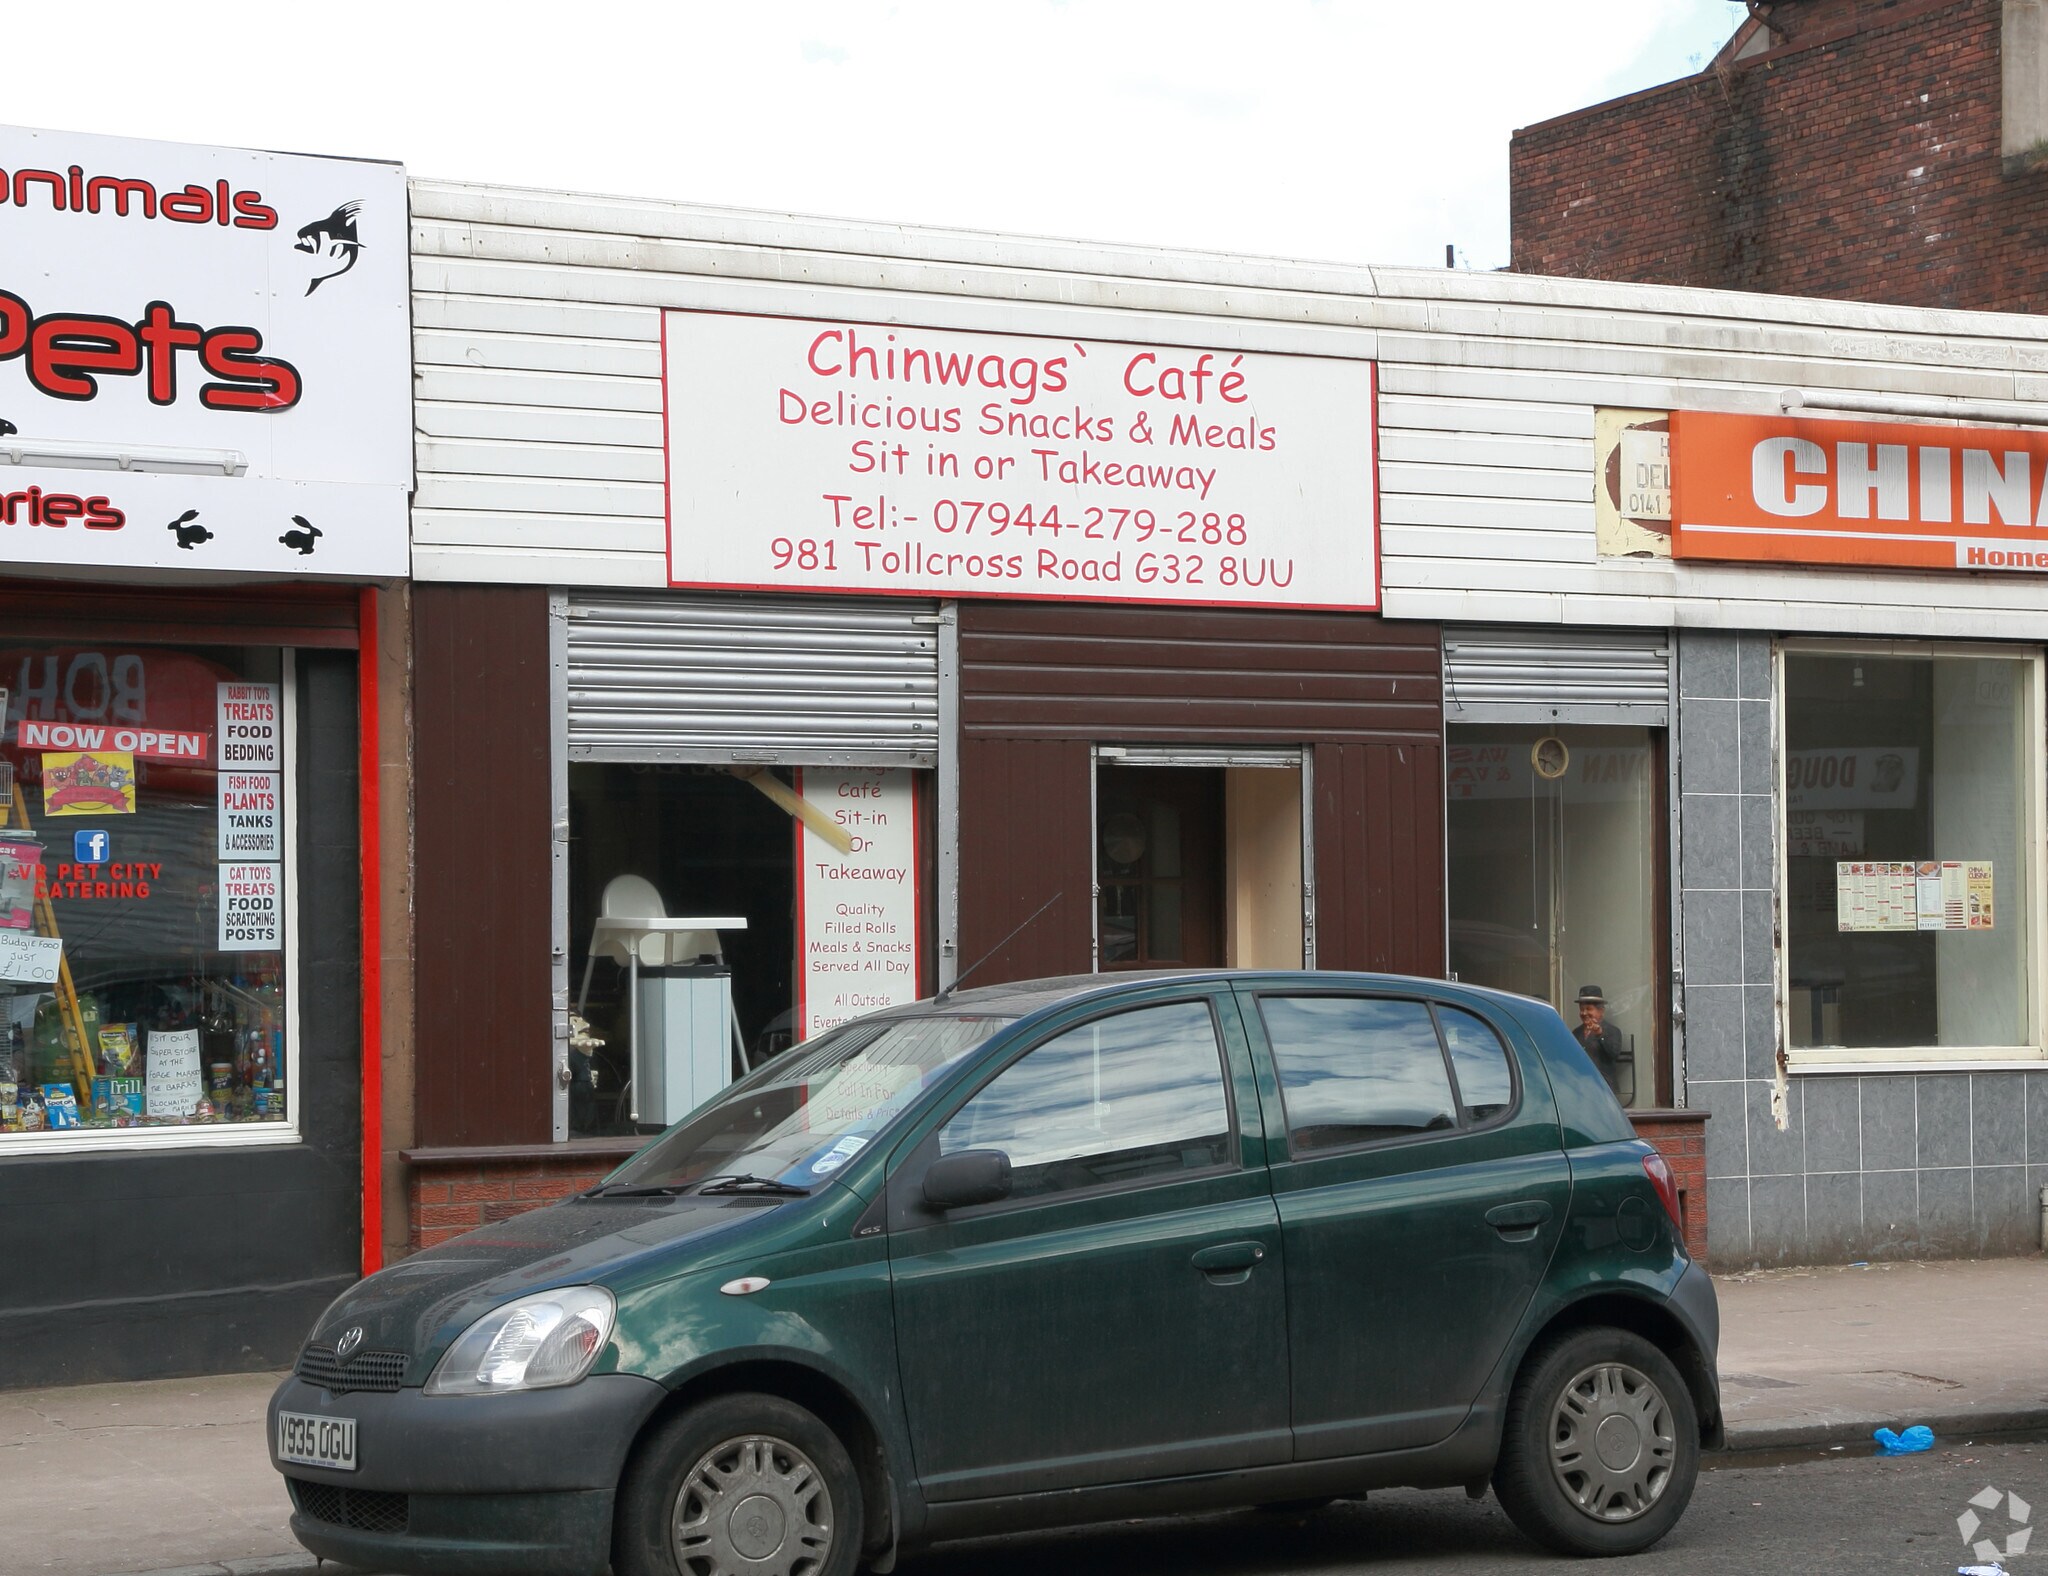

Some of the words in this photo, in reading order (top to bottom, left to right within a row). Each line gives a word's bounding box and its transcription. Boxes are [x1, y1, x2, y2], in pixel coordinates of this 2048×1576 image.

[0, 164, 279, 231] nimals
[1123, 352, 1249, 405] Café
[779, 388, 961, 433] Delicious
[978, 403, 1114, 442] Snacks
[1128, 410, 1154, 446] &
[1168, 413, 1277, 451] Meals
[849, 440, 910, 476] Sit
[926, 443, 960, 478] in
[974, 456, 1015, 481] or
[1031, 448, 1217, 501] Takeaway
[1752, 436, 2048, 527] CHIN
[0, 485, 126, 531] ries
[822, 494, 918, 531] Tel:-
[933, 499, 1248, 546] 07944-279-288
[770, 537, 838, 571] 981
[854, 540, 1023, 578] Tollcross
[1037, 548, 1121, 582] Road
[1135, 552, 1204, 584] G32
[1218, 556, 1294, 588] 8UU
[227, 686, 251, 700] RABBIT
[253, 687, 270, 700] TOYS
[223, 703, 274, 721] TREATS
[26, 724, 106, 749] NOW
[114, 731, 200, 756] OPEN
[227, 725, 273, 739] FOOD
[225, 744, 274, 762] BEDDING
[228, 776, 247, 790] FISH
[248, 776, 271, 790] FOOD
[837, 780, 882, 799] Café
[224, 792, 275, 811] PLANTS
[228, 815, 273, 828] TANKS
[834, 809, 887, 825] Sit-in
[225, 833, 230, 851] &
[231, 833, 275, 851] ACCESSORIES
[850, 836, 873, 853] Or
[18, 863, 48, 881] VR
[58, 863, 100, 881] PET
[110, 863, 163, 880] CITY
[229, 866, 247, 880] CAT
[248, 866, 271, 880] TOYS
[815, 863, 907, 885] Takeaway
[33, 881, 151, 899] CATERING
[224, 882, 275, 896] TREATS
[228, 897, 274, 911] FOOD
[835, 903, 885, 918] Quality
[225, 911, 275, 927] SCRATCHING
[825, 922, 861, 934] Filled
[865, 922, 896, 934] Rolls
[225, 928, 275, 941] POSTS
[809, 941, 848, 953] Meals
[852, 941, 862, 953] &
[866, 941, 911, 953] Snacks
[812, 960, 859, 972] Served
[864, 960, 881, 972] All
[886, 960, 910, 975] Day
[834, 993, 848, 1006] All
[851, 993, 891, 1006] Outside
[280, 1415, 315, 1457] Y935
